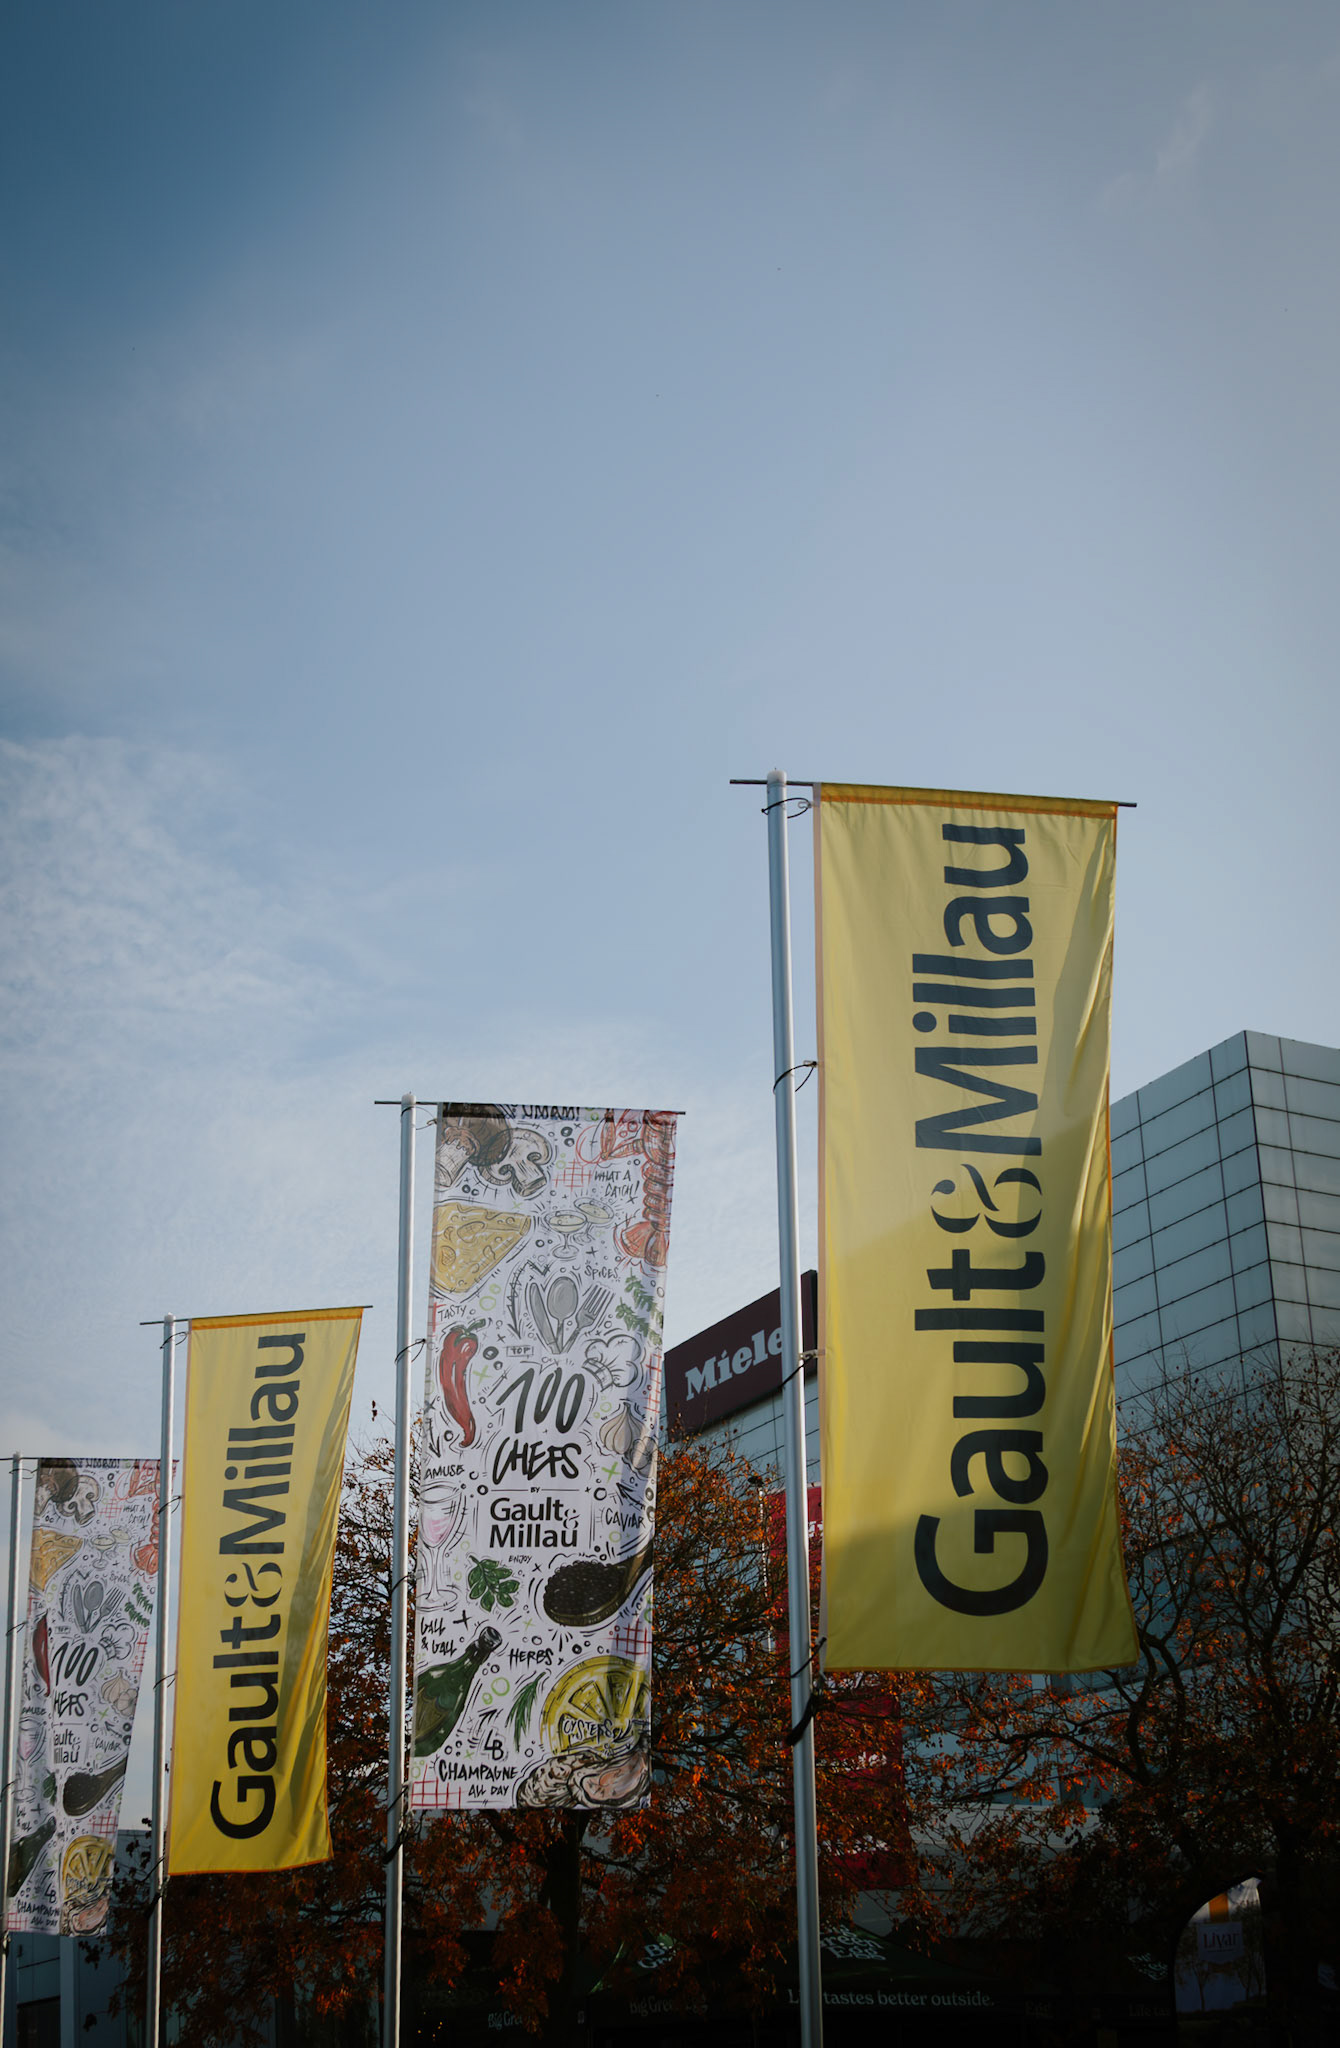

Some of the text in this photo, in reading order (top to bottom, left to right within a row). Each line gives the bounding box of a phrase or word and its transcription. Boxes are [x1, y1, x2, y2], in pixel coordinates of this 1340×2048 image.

[594, 1170, 631, 1183] WHAT A
[438, 1304, 467, 1321] TASTY
[685, 1326, 783, 1401] Miele
[496, 1366, 585, 1434] 100
[424, 1464, 465, 1480] AMUSE
[492, 1436, 582, 1485] CHEFS
[605, 1507, 646, 1532] CAVIAR
[489, 1524, 578, 1549] Millau
[508, 1554, 533, 1565] ENJOY
[51, 1641, 99, 1687] 100
[508, 1648, 554, 1671] HERBS
[53, 1690, 89, 1718] HEFS
[438, 1759, 519, 1782] CHAMPAGNE
[468, 1784, 509, 1799] ALL DAY
[823, 1991, 874, 2005] tastes
[877, 1990, 928, 2005] better
